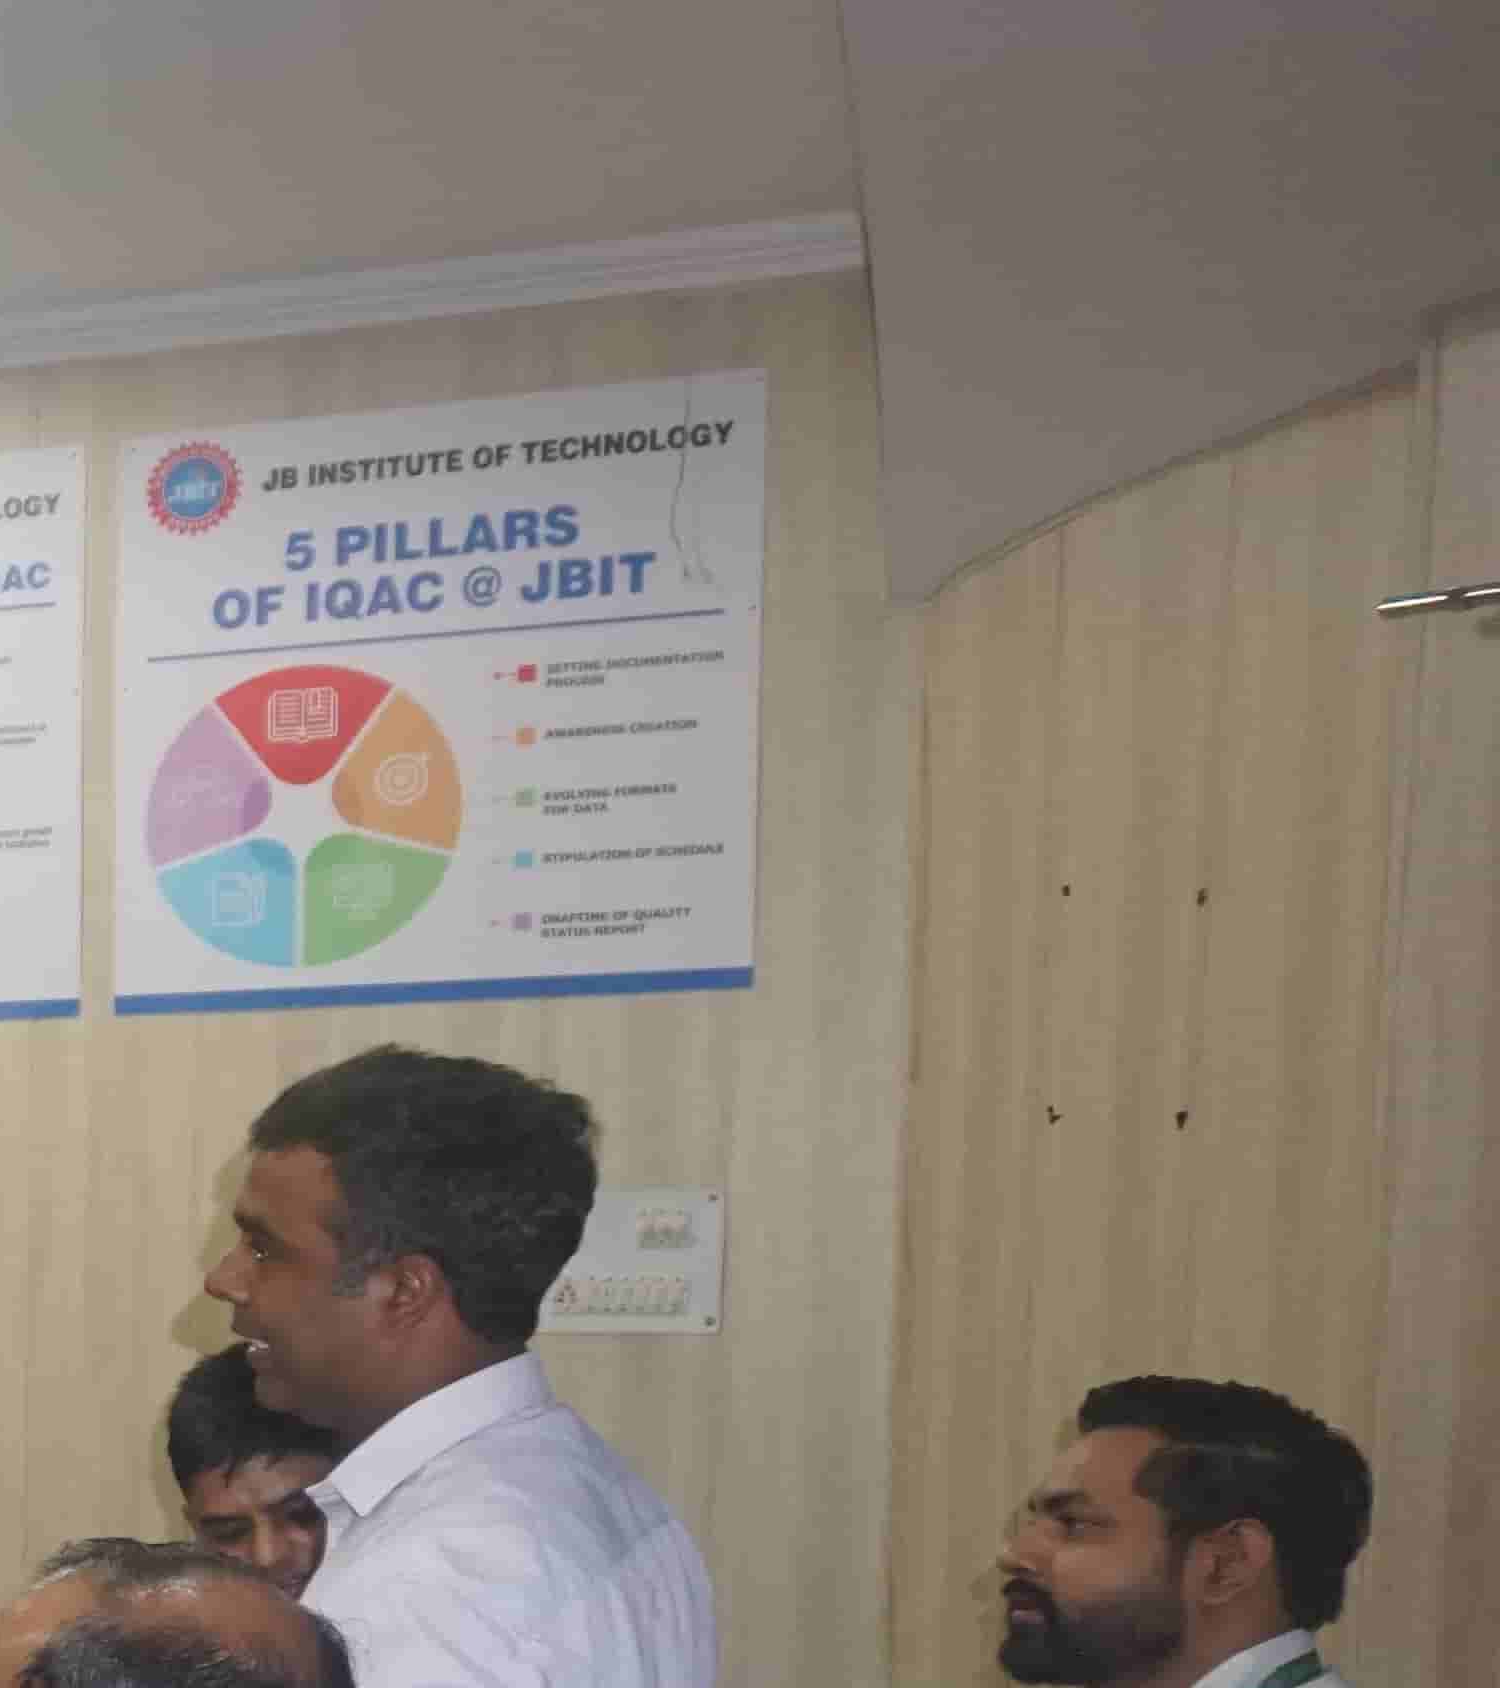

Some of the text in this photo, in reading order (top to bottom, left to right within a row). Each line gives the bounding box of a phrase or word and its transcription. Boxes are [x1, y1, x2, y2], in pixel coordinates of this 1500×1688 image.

[262, 420, 734, 492] JB INSTITUTE OF TECHNOLOGY
[285, 505, 580, 572] 5 PILLARS
[212, 551, 656, 630] OF IQAC @ JBIT
